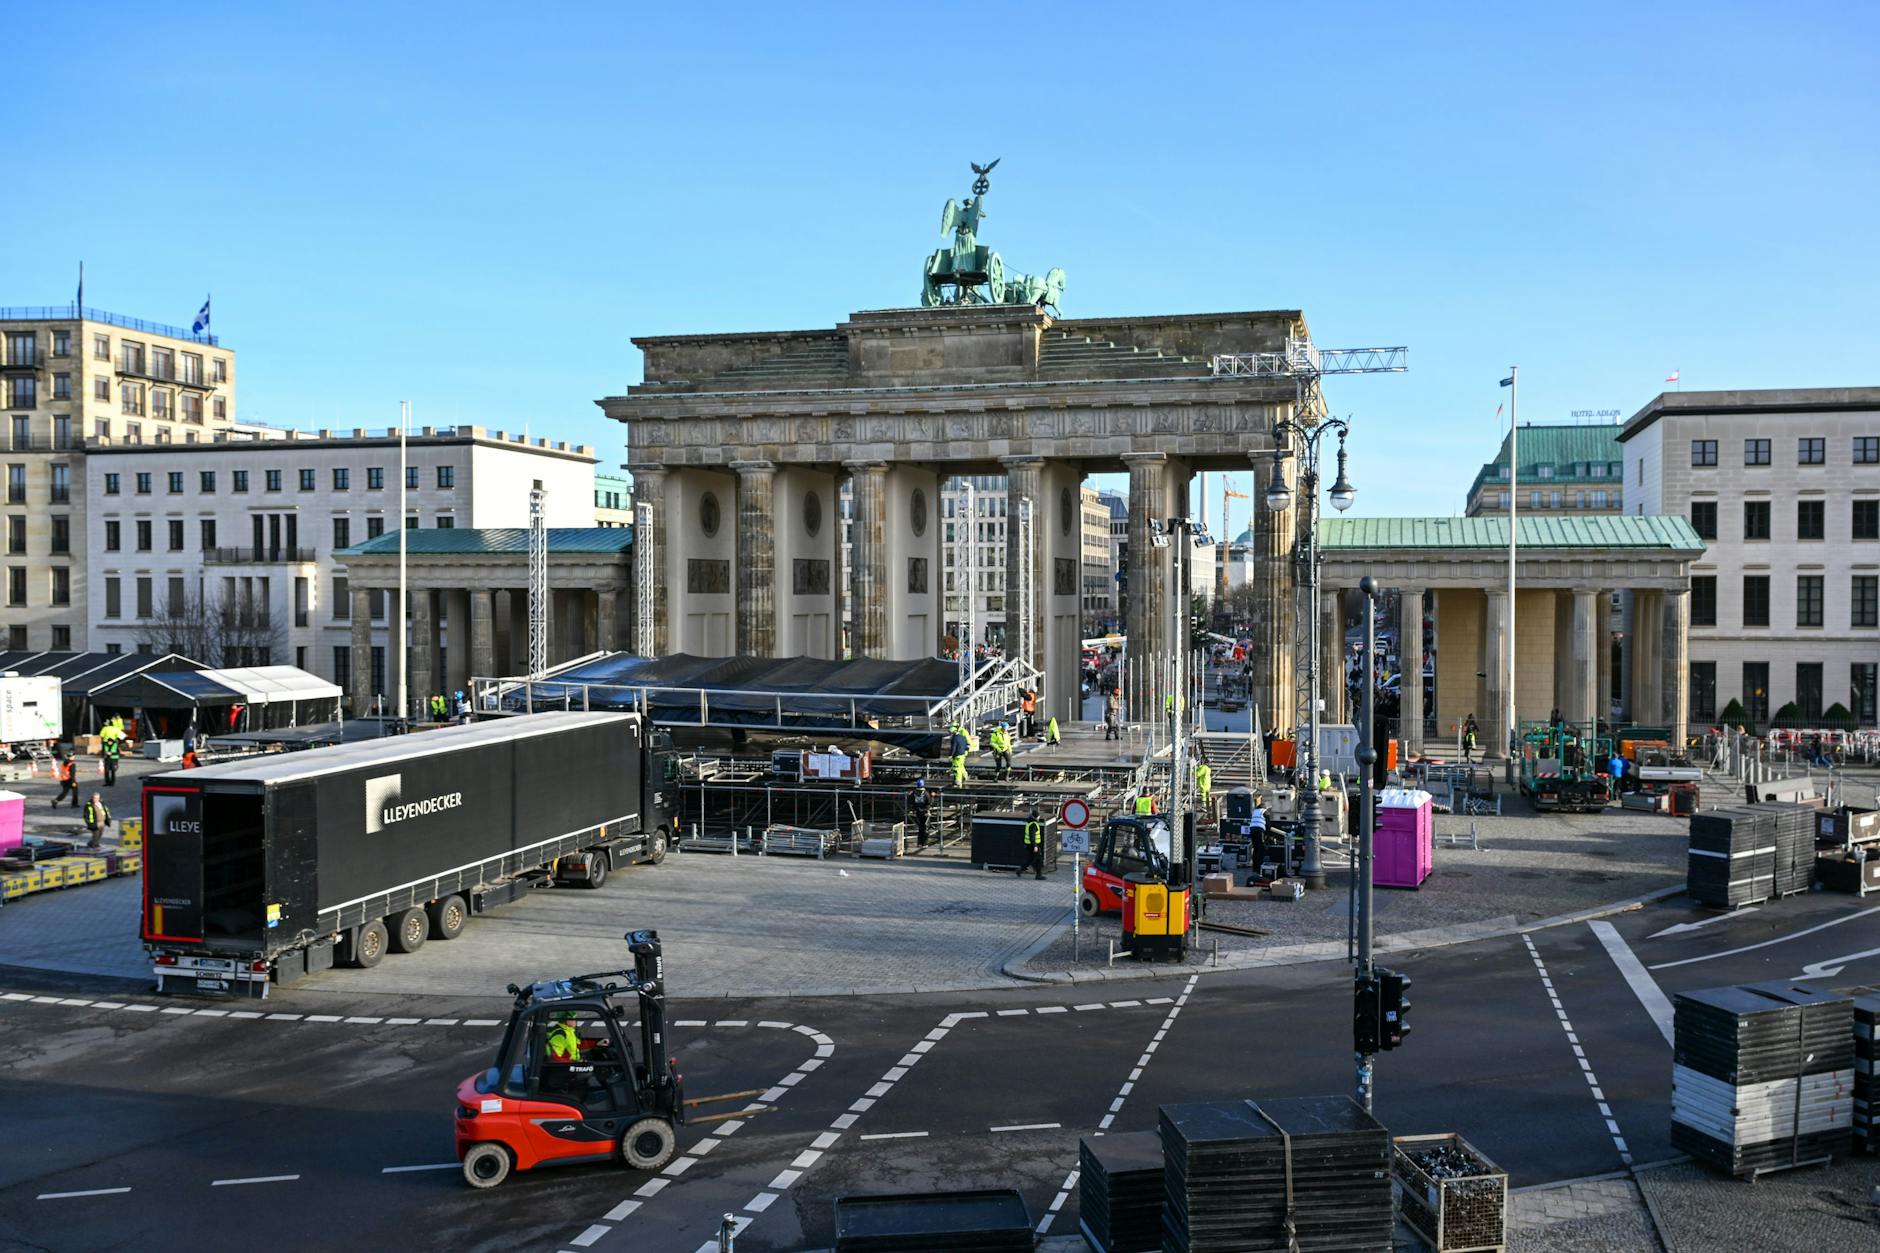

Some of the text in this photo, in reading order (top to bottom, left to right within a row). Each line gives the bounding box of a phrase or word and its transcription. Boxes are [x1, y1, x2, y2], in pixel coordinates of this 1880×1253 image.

[6, 689, 14, 713] space
[384, 792, 462, 825] LLEYENDECKER
[169, 820, 201, 834] LLEYE
